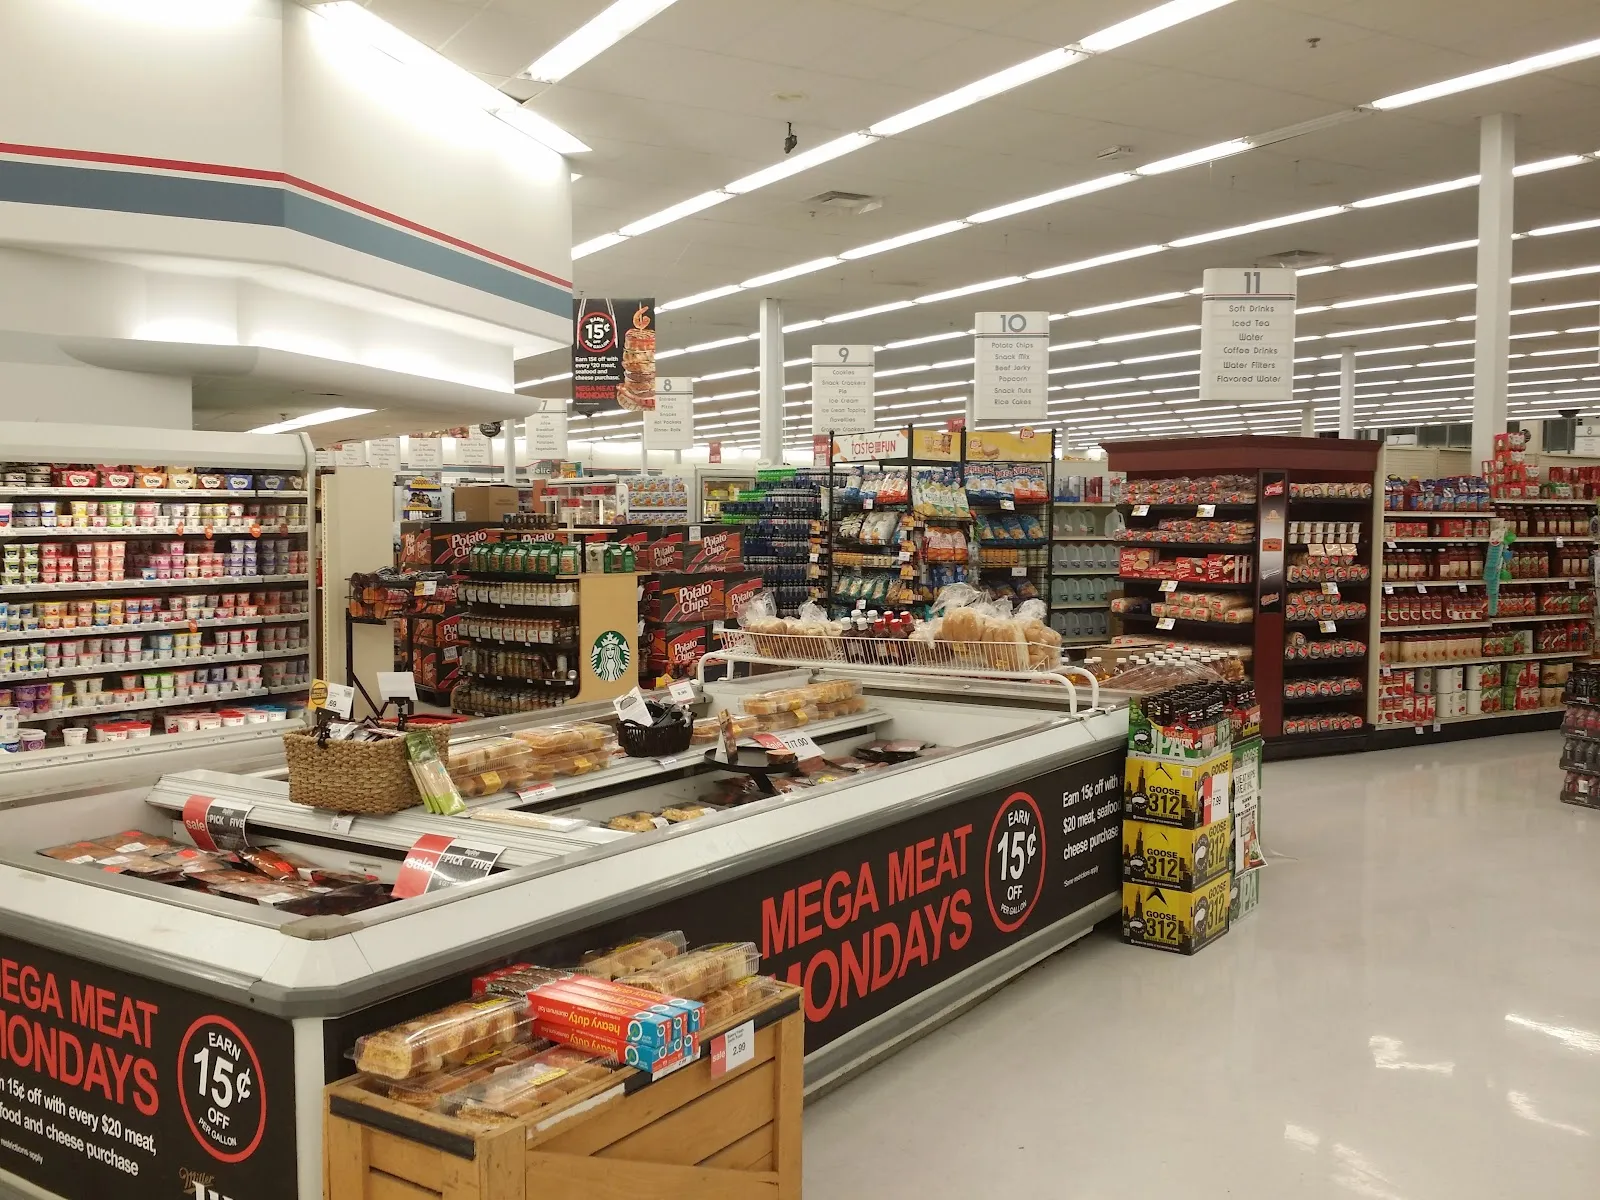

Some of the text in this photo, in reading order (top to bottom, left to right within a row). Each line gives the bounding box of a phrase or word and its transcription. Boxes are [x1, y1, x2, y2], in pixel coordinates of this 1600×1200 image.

[1244, 271, 1260, 294] 11
[585, 323, 610, 340] 15¢
[1000, 314, 1027, 333] 10
[1239, 333, 1264, 341] Water
[1016, 342, 1034, 350] Chips
[1224, 346, 1278, 354] Coffee Drinks
[838, 347, 849, 363] 9
[664, 378, 672, 392] 8
[542, 400, 548, 410] 7
[851, 440, 875, 455] taste
[882, 440, 896, 453] FUN
[452, 531, 487, 549] Potato
[704, 534, 727, 549] Potato
[654, 545, 675, 559] Potato
[705, 545, 725, 556] Chips
[655, 555, 674, 567] Chips
[680, 583, 712, 604] Potato
[731, 590, 754, 606] Potato
[682, 597, 709, 614] Chips
[674, 640, 697, 655] Potato
[1164, 730, 1194, 739] GOOSE
[1212, 760, 1229, 776] GOOSE
[1062, 790, 1080, 808] Earn
[1080, 782, 1094, 801] 15¢
[1094, 778, 1104, 796] off
[1104, 774, 1118, 791] with
[1149, 785, 1180, 796] GOOSE
[1148, 793, 1180, 816] 312
[1212, 795, 1222, 807] 7.99
[186, 818, 206, 832] sale
[209, 814, 244, 828] PICK FIVE
[1008, 810, 1031, 827] EARN
[1062, 815, 1076, 836] $20
[1077, 808, 1096, 829] meat,
[1209, 820, 1227, 838] GOOSE
[1063, 825, 1119, 860] cheese purchase
[1208, 832, 1225, 869] 312
[997, 826, 1037, 881] 15¢
[1146, 848, 1178, 859] GOOSE
[444, 855, 492, 871] PICK FIVE
[1146, 856, 1178, 879] 312
[761, 824, 973, 961] MEGA MEAT
[1007, 884, 1024, 901] OFF
[1208, 880, 1227, 900] GOOSE
[1000, 900, 1027, 916] PER GALLON
[1146, 910, 1177, 921] GOOSE
[1208, 894, 1225, 931] 312
[1146, 917, 1177, 941] 312
[70, 979, 159, 1048] MEAT
[537, 1005, 546, 1014] foil
[544, 1006, 569, 1018] aluminum
[568, 1011, 590, 1028] duty
[591, 1016, 620, 1036] heavy
[208, 1032, 241, 1062] EARN
[570, 1034, 590, 1049] duty
[732, 1042, 746, 1056] 2.99
[712, 1050, 726, 1062] sale
[193, 1047, 252, 1109] 15¢
[7, 1078, 25, 1101] 15¢
[27, 1088, 42, 1106] off
[44, 1095, 66, 1117] with
[68, 1106, 99, 1133] every
[102, 1114, 122, 1138] $20
[124, 1128, 156, 1156] meat,
[207, 1107, 230, 1130] OFF
[198, 1116, 237, 1147] PER GALLON
[0, 1138, 44, 1165] restrictions apply
[24, 1116, 43, 1136] and
[46, 1124, 84, 1152] cheese
[86, 1142, 139, 1177] purchase
[178, 1166, 214, 1190] Miller
